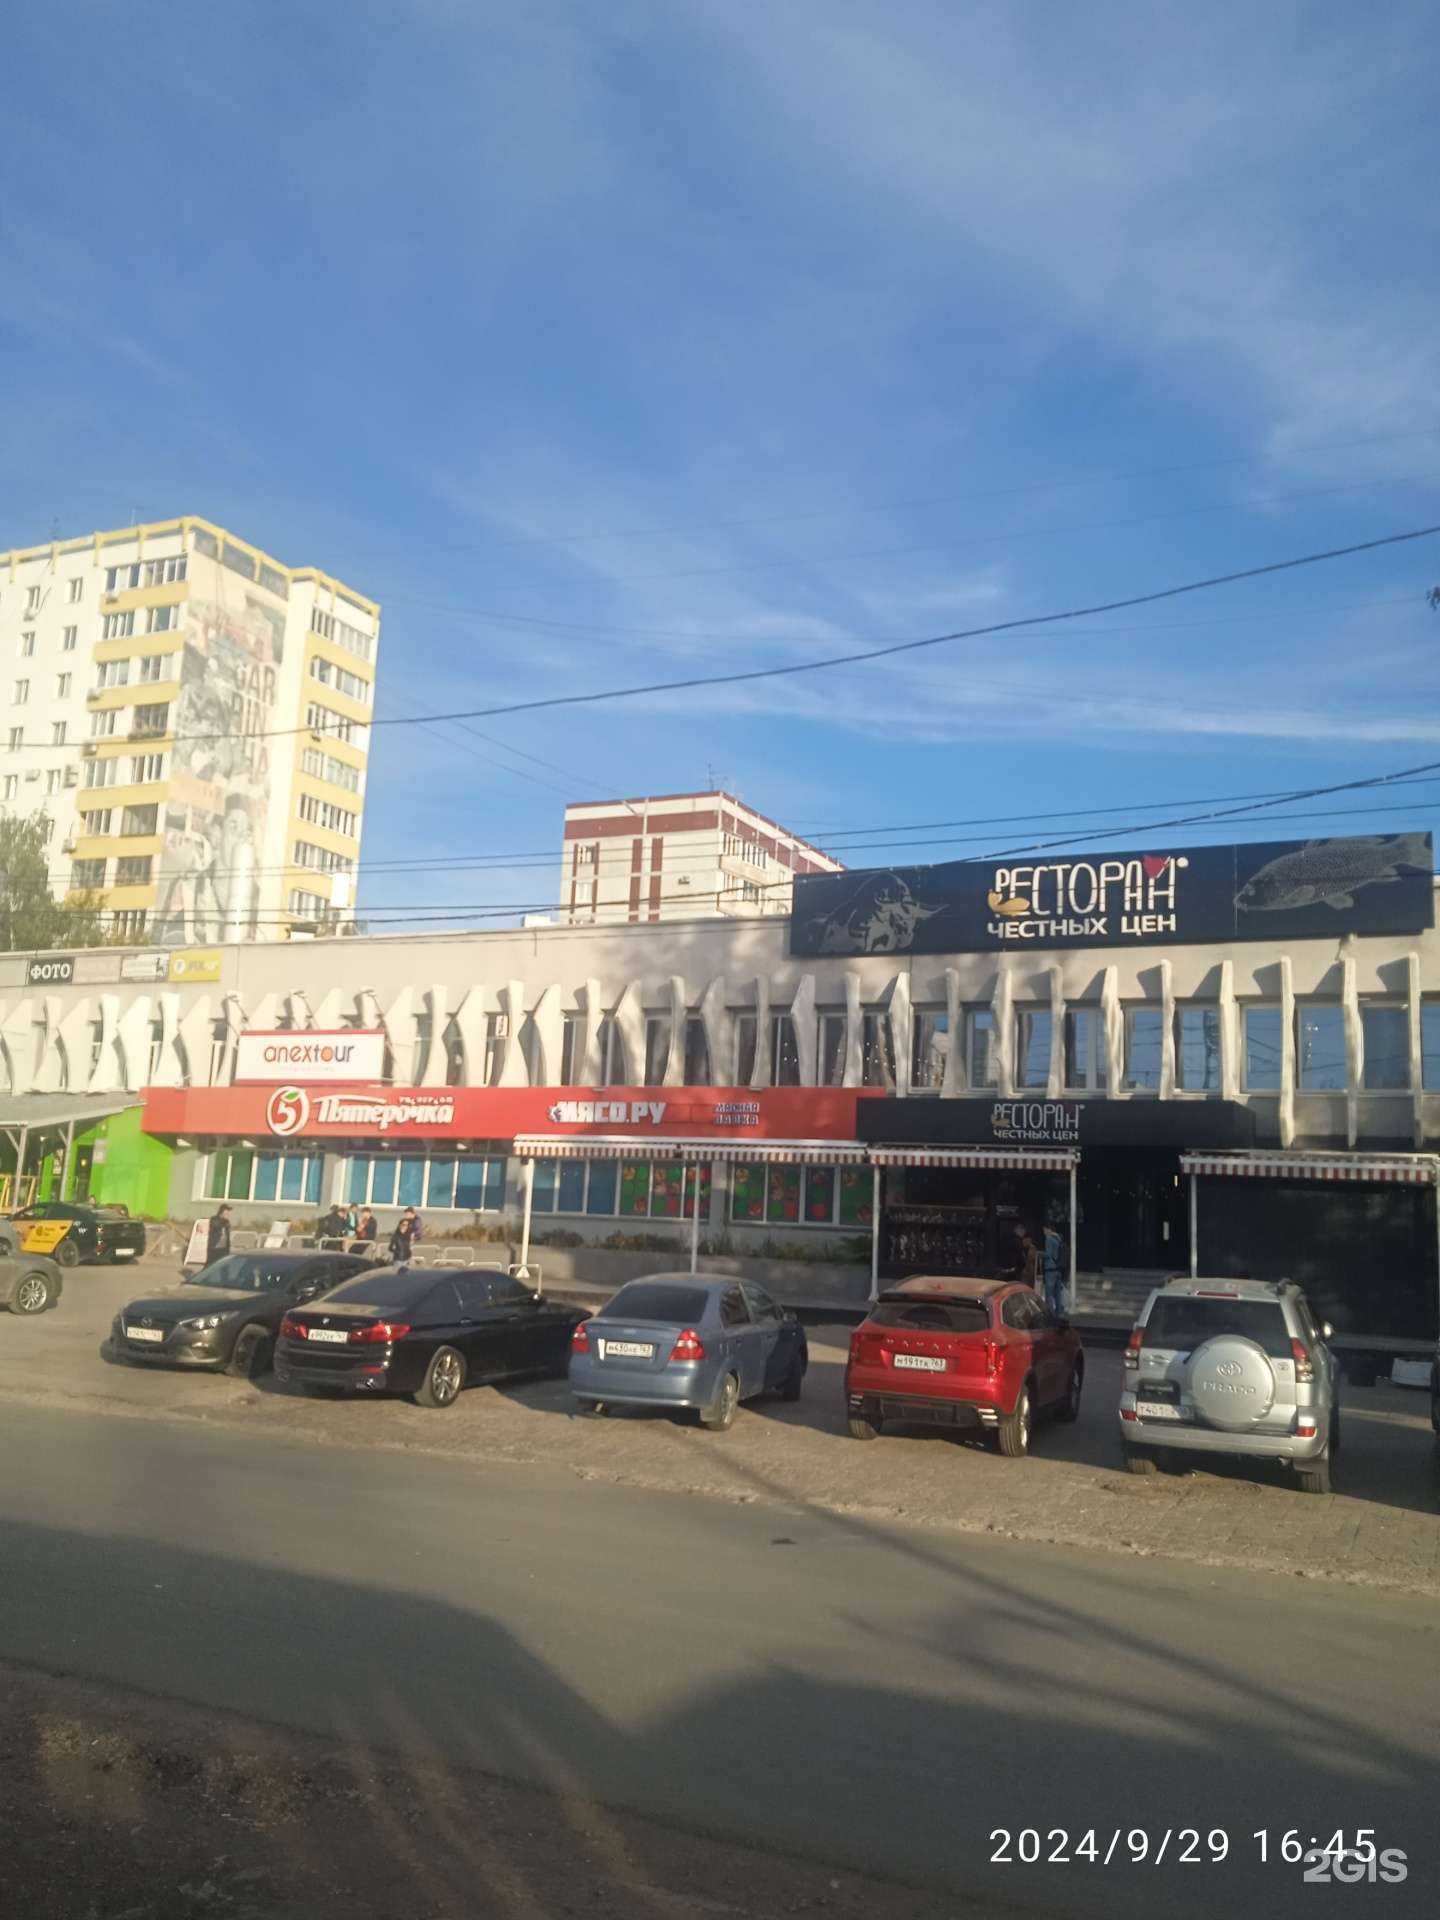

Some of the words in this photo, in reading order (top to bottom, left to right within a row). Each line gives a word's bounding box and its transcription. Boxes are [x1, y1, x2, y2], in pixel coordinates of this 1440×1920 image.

[988, 856, 1176, 916] РЕСТОРАН
[987, 916, 1108, 939] ЧЕСТНЫХ
[1121, 913, 1176, 937] ЦЕН
[30, 962, 71, 981] ФОТО
[263, 1043, 355, 1063] anextour
[993, 1128, 1051, 1140] ЧЕСТНЫХ
[1052, 1130, 1079, 1141] ЦЕН
